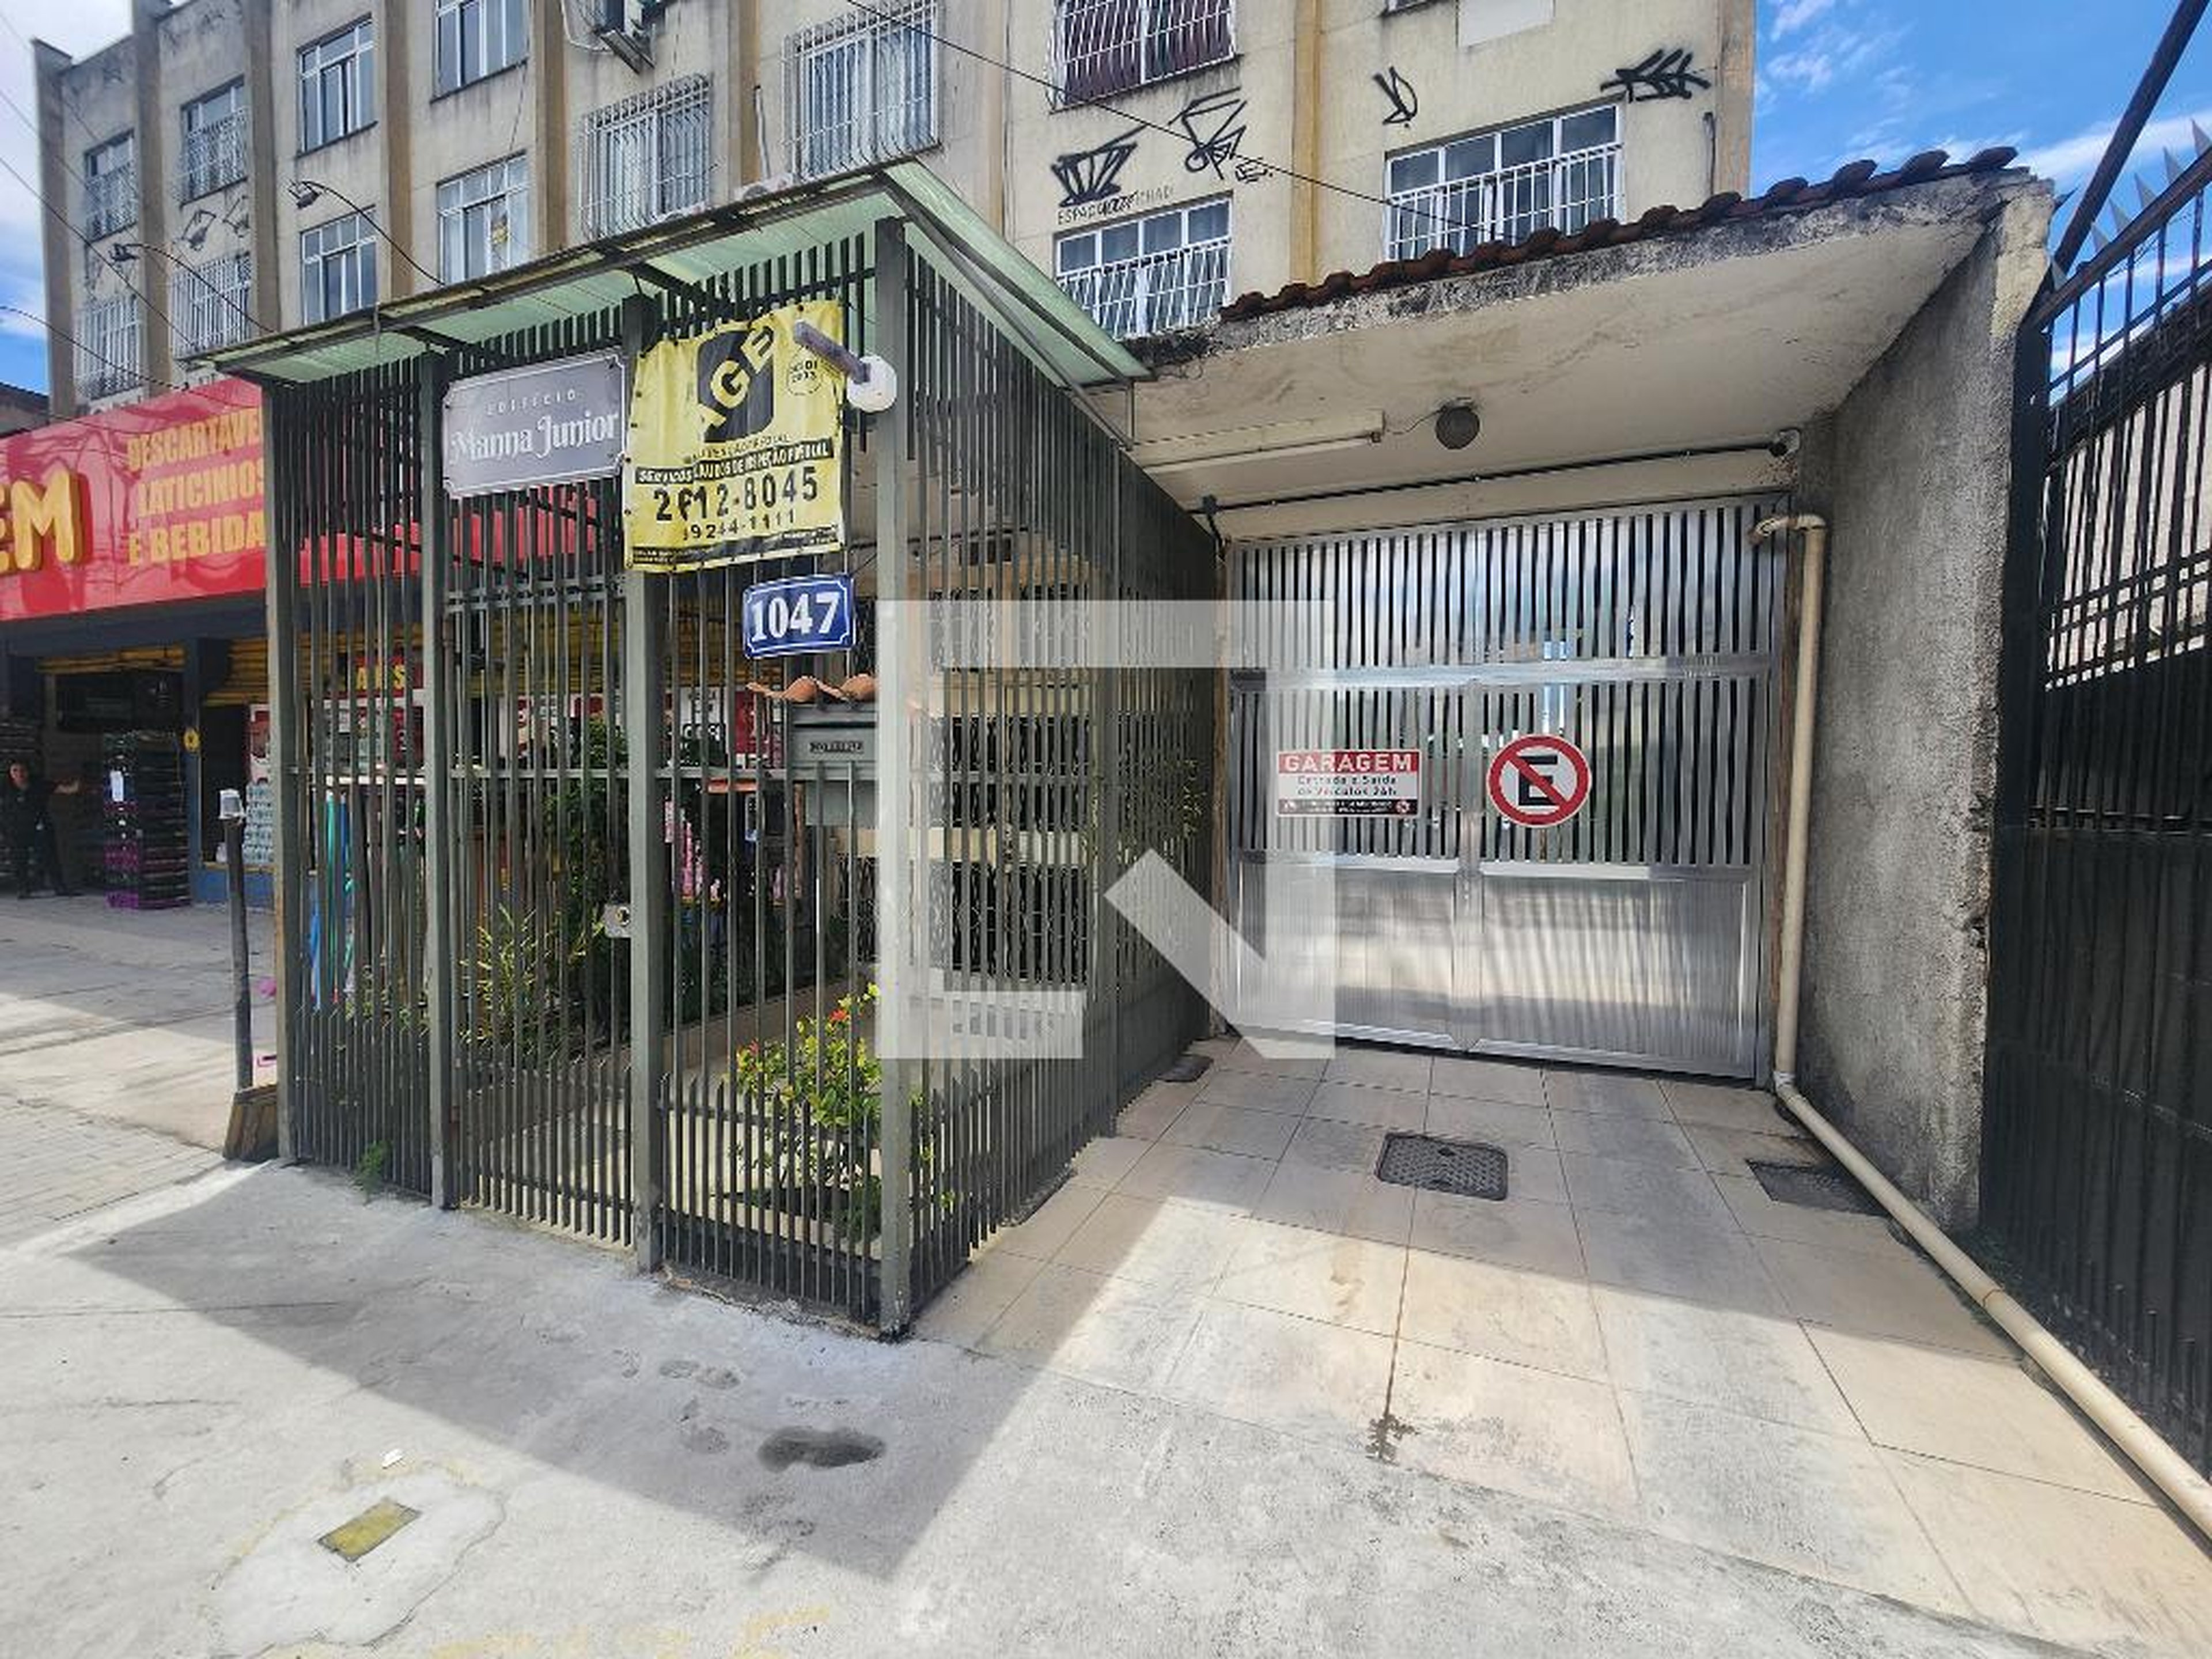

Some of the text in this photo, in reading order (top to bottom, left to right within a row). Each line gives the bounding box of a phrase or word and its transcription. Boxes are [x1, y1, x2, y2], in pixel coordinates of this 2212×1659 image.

[536, 410, 619, 459] Junior
[751, 591, 840, 642] 1047
[1285, 753, 1412, 772] GARAGEM
